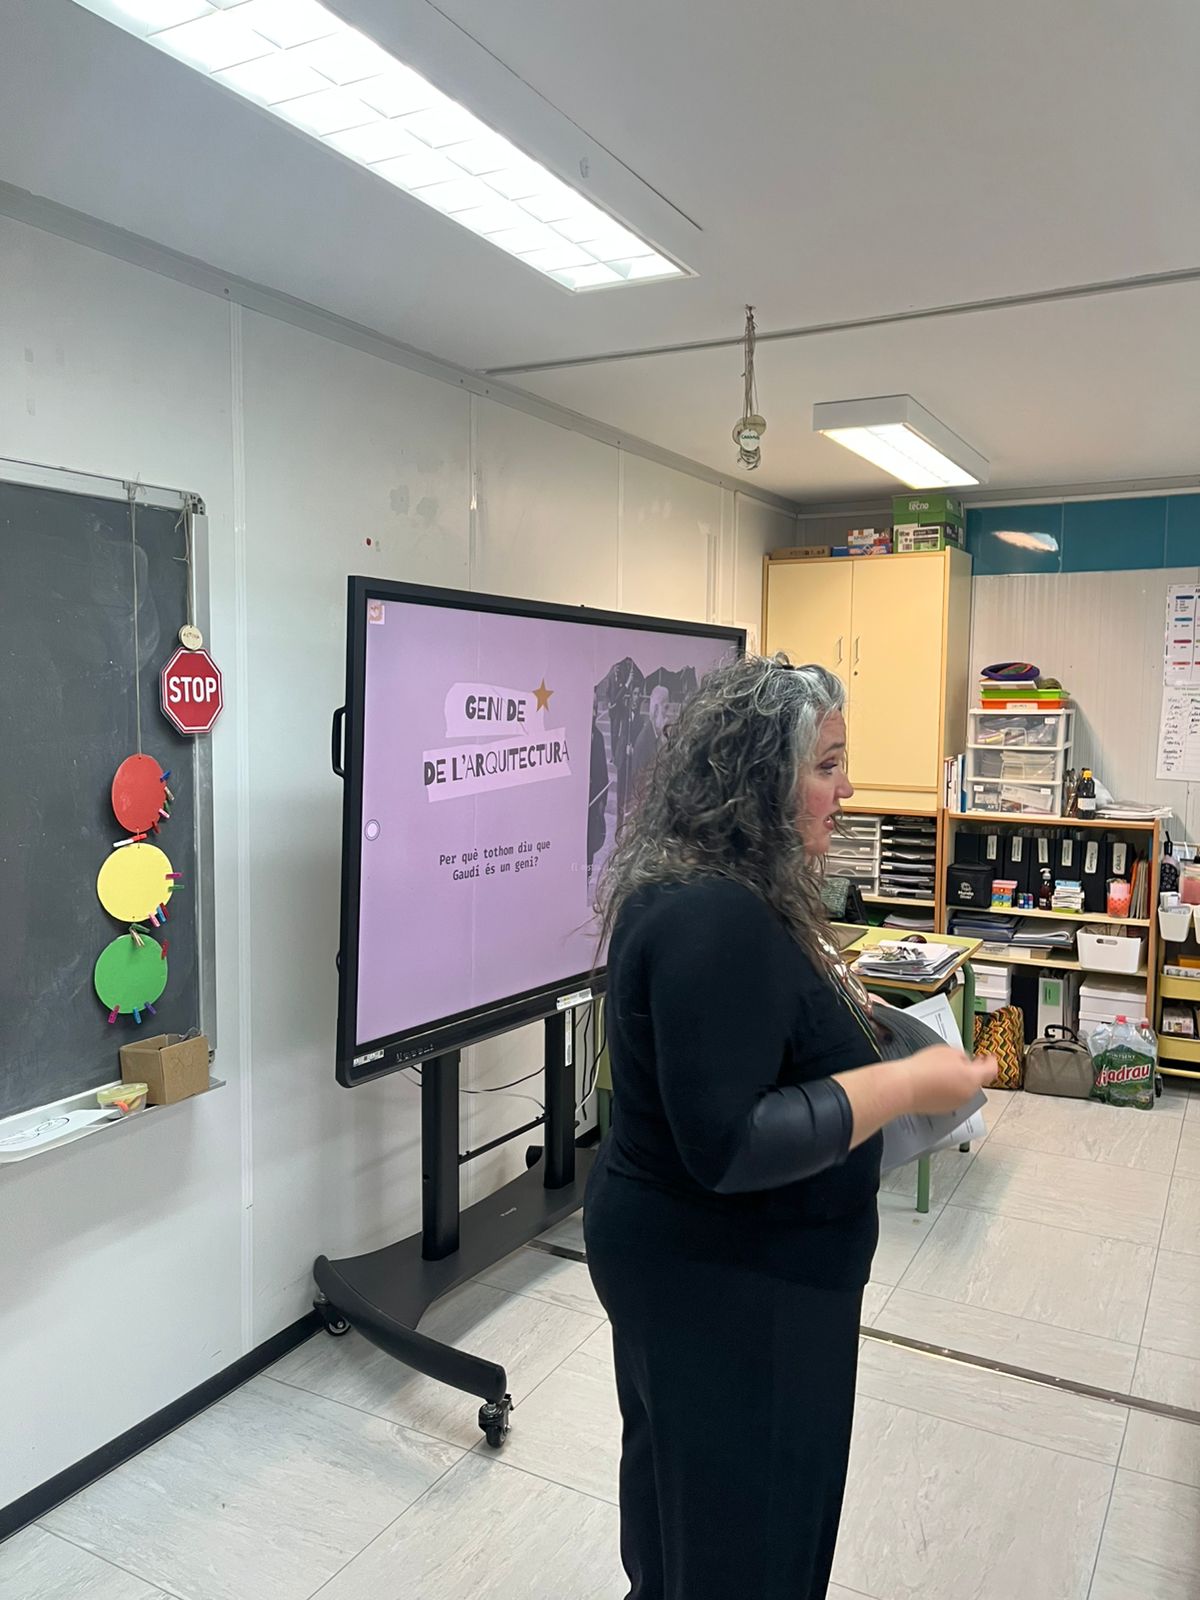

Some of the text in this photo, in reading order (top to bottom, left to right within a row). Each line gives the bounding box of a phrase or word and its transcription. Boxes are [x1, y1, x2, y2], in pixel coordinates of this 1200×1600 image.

[169, 676, 217, 703] STOP
[465, 695, 526, 722] GENI DE
[424, 740, 570, 786] DE L'ARQUITECTURA
[439, 840, 551, 865] Per què tothom diu que
[452, 856, 539, 880] Gaudí és un geni?
